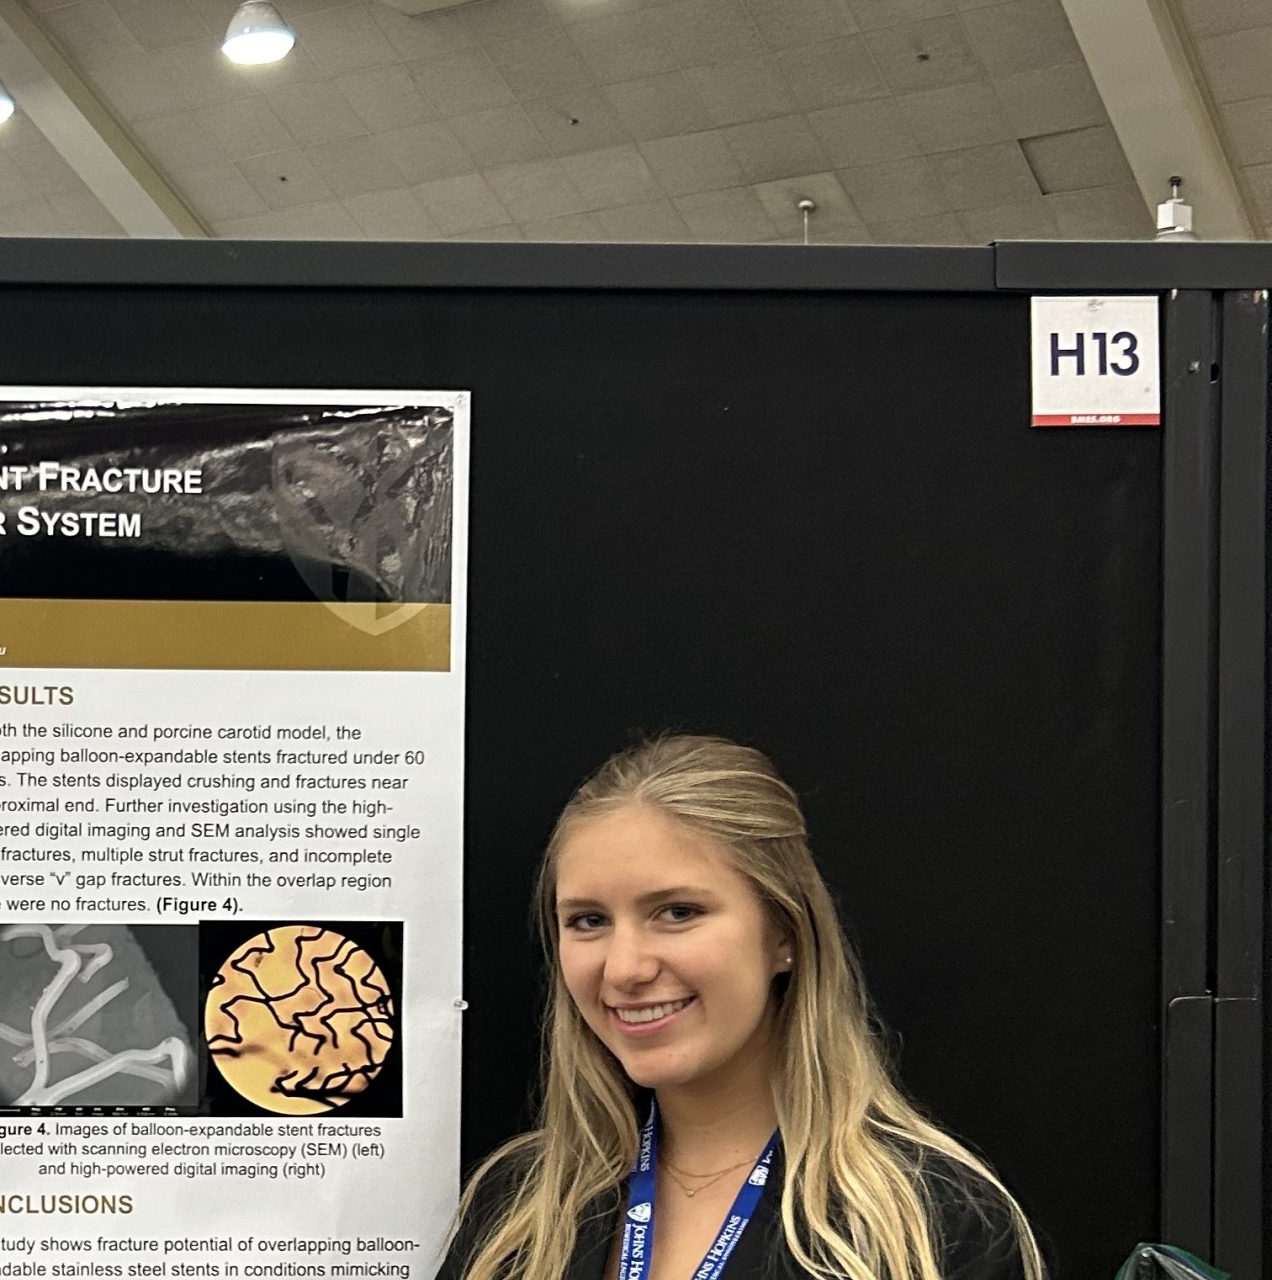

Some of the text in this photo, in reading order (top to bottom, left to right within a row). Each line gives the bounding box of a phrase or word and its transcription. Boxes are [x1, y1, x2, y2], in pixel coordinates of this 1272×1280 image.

[1050, 331, 1139, 376] H13
[37, 1123, 50, 1135] 4.
[56, 1123, 108, 1138] Images
[113, 1123, 127, 1135] of
[132, 1123, 273, 1139] balloon-expandable
[278, 1125, 313, 1136] stent
[318, 1123, 381, 1136] fractures
[41, 1238, 91, 1251] shows
[97, 1237, 158, 1251] fracture
[165, 1237, 231, 1254] potential
[238, 1237, 253, 1251] of
[258, 1238, 351, 1255] overlapping
[357, 1238, 420, 1251] balloon-
[631, 1224, 648, 1258] JOHNS
[708, 1215, 741, 1261] HOPKINS
